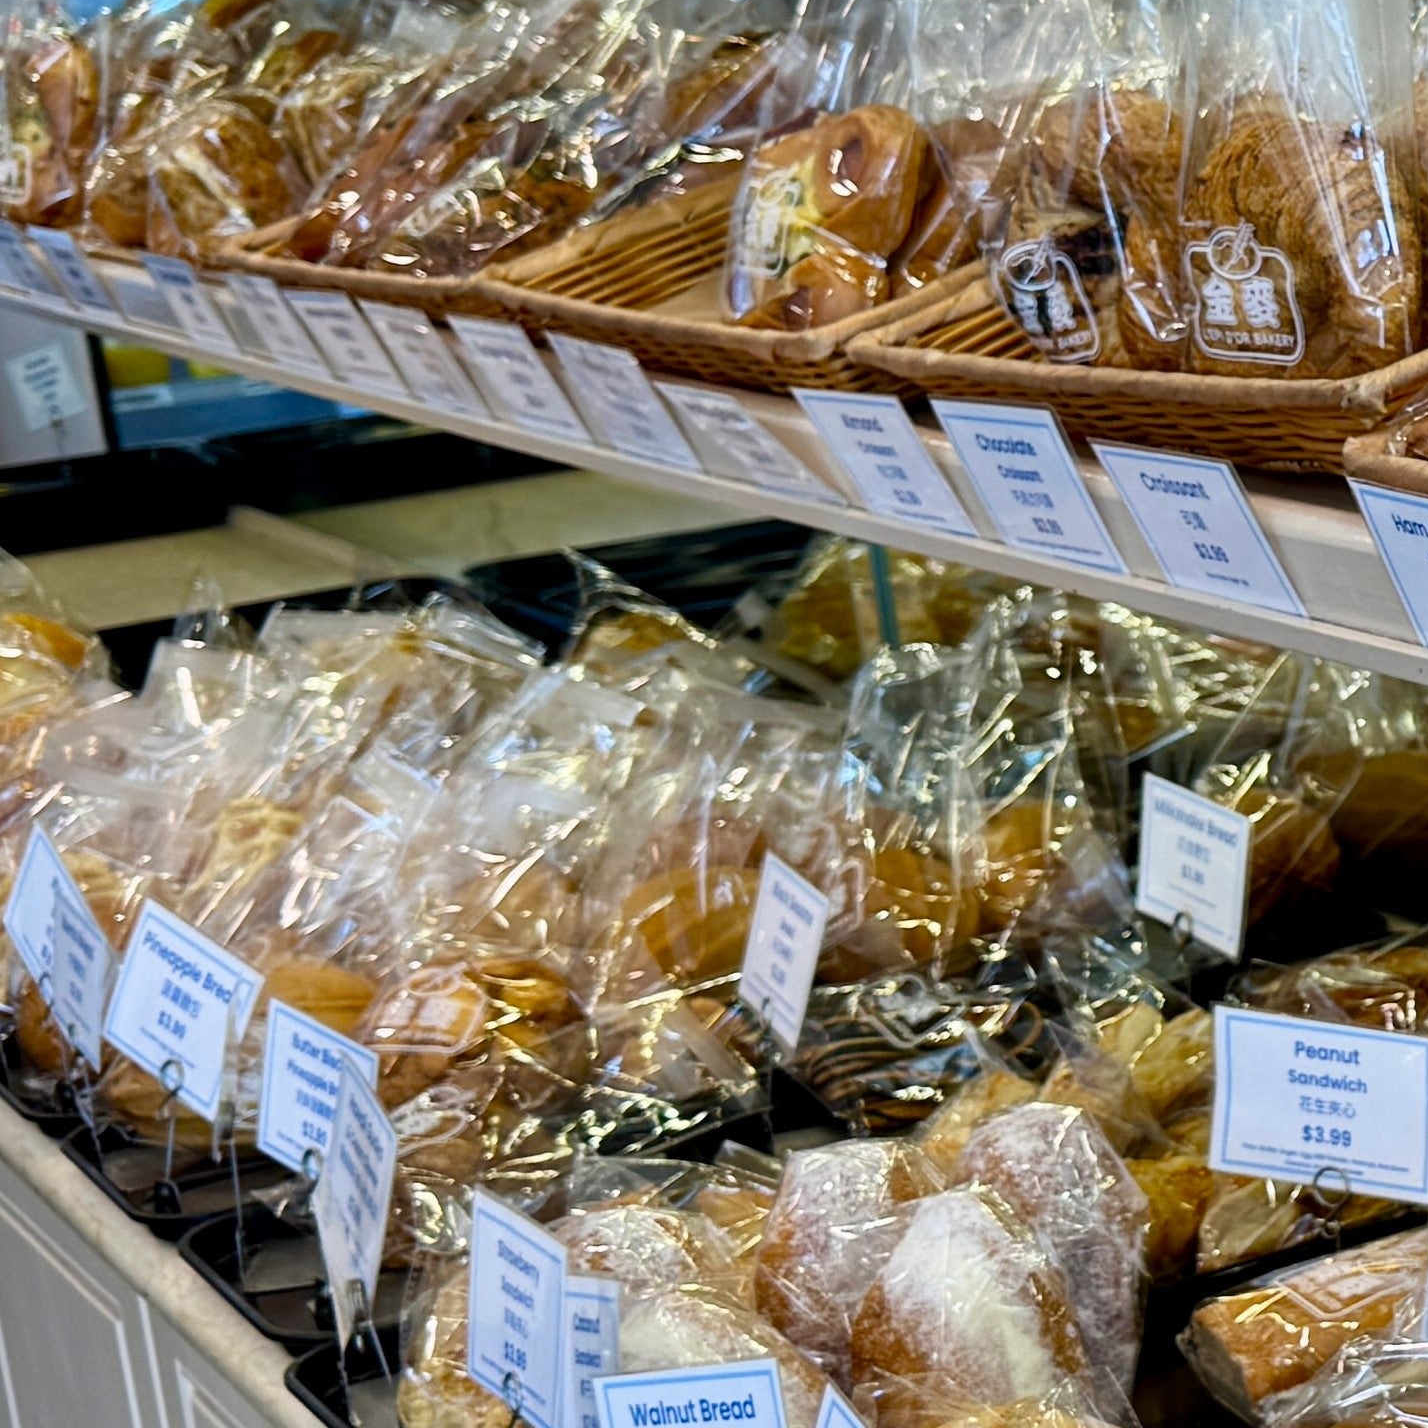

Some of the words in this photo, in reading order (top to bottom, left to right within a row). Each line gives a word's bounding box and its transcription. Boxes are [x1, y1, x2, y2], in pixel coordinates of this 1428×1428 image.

[1139, 472, 1211, 500] Croissant
[1391, 512, 1428, 543] Ham
[141, 929, 203, 988] Pineapple
[1294, 1039, 1361, 1066] Peanut
[1287, 1068, 1369, 1095] Sandwich
[1302, 1124, 1352, 1148] $3.99
[629, 1399, 699, 1428] Walnut
[700, 1393, 757, 1422] Bread
